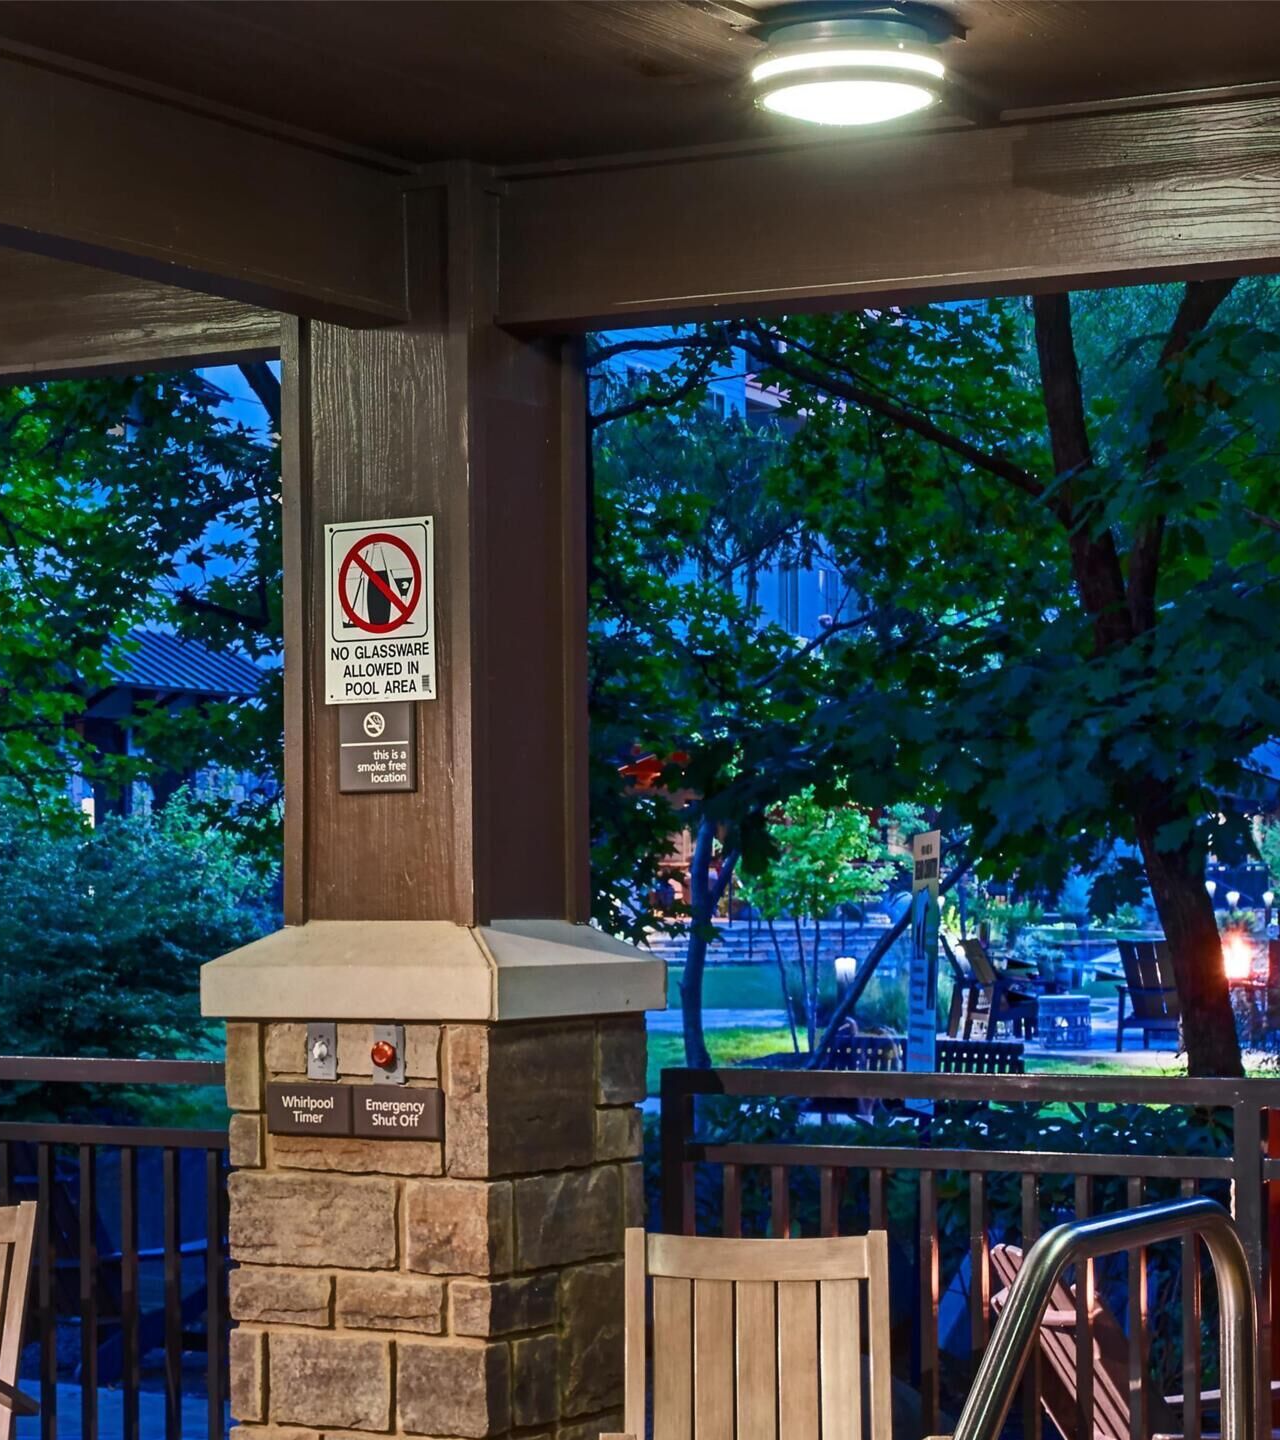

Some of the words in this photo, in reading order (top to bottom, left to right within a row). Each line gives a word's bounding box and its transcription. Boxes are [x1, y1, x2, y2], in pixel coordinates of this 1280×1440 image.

[331, 647, 349, 661] NO
[355, 642, 429, 658] GLASSWARE
[343, 662, 402, 678] ALLOWED
[407, 661, 419, 674] IN
[345, 681, 379, 696] POOL
[384, 679, 417, 694] AREA
[373, 749, 389, 760] this
[391, 750, 399, 760] is
[401, 752, 406, 760] a
[357, 761, 385, 772] smoke
[388, 760, 407, 772] free
[371, 772, 407, 783] location
[282, 1096, 334, 1111] Whirlpool
[366, 1099, 424, 1115] Emergency
[293, 1111, 323, 1124] Timer
[372, 1114, 397, 1127] Shut
[400, 1115, 419, 1127] Off
